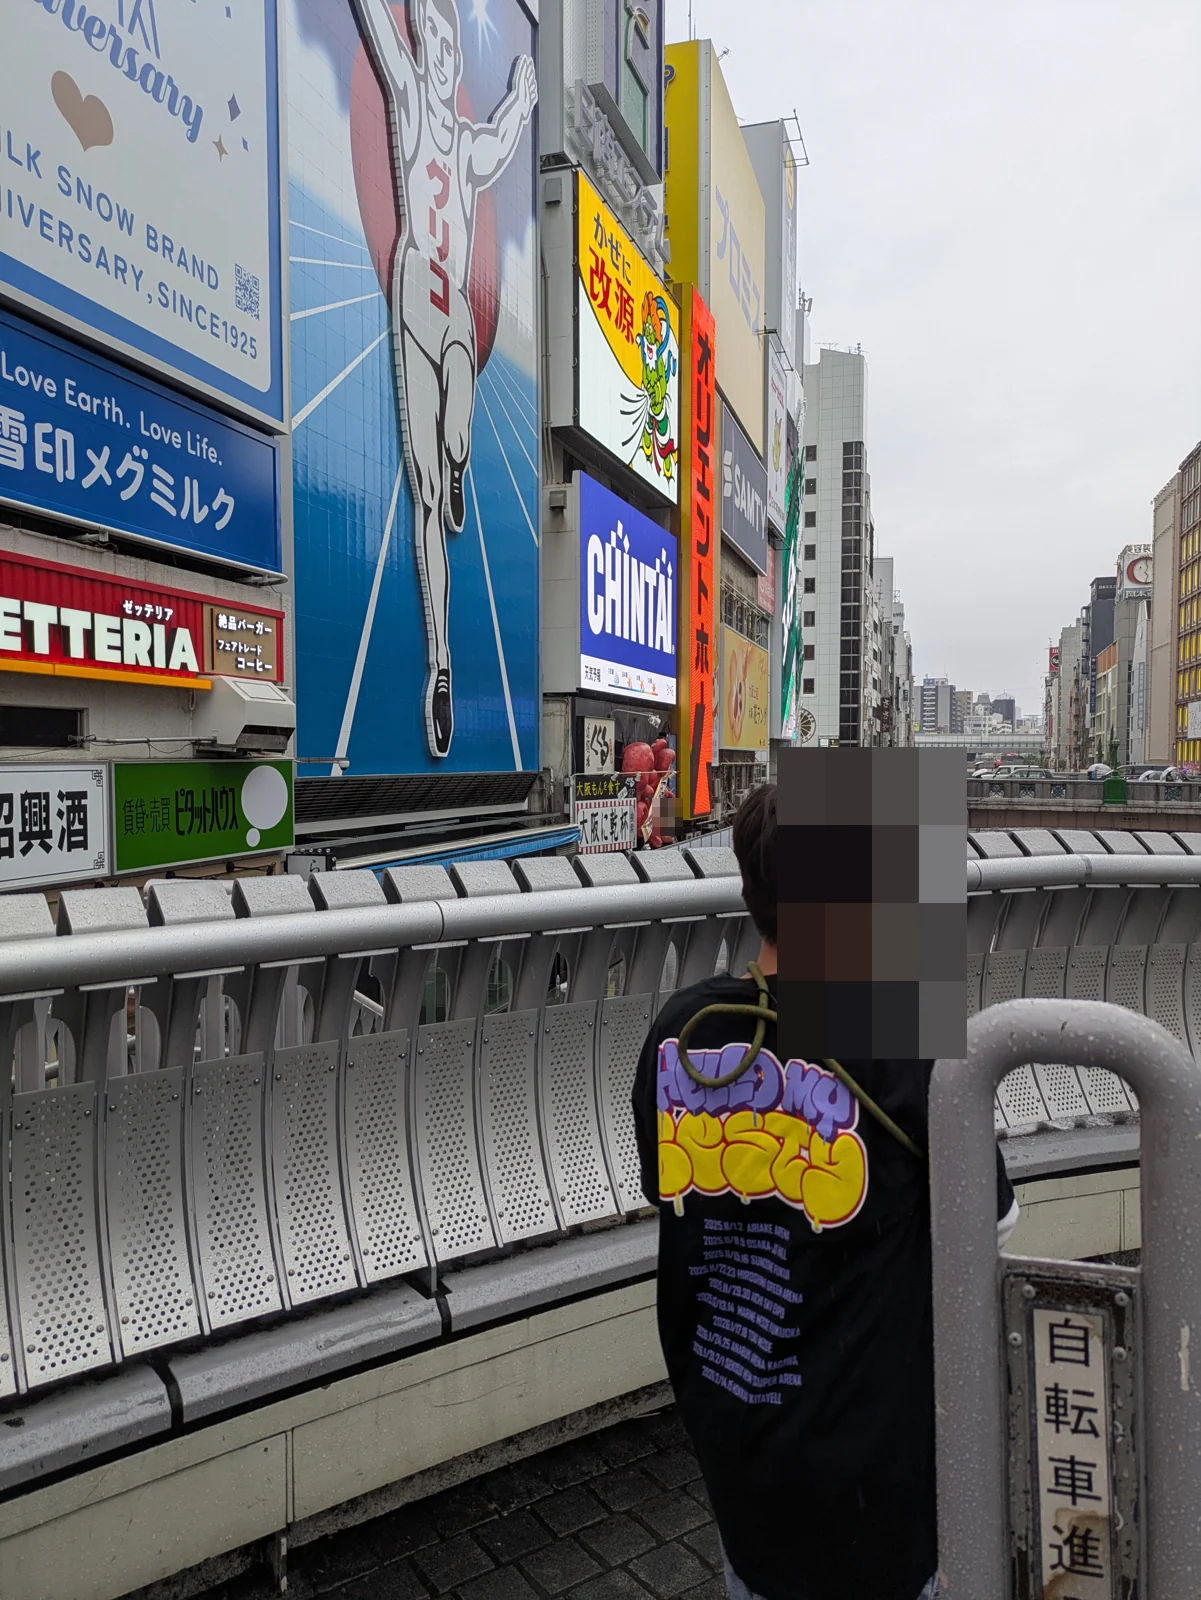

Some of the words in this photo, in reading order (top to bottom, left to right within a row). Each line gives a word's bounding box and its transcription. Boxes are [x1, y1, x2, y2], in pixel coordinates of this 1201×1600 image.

[0, 126, 42, 180] LK
[57, 165, 135, 237] SNOW
[146, 223, 219, 291] BRAND
[425, 156, 452, 318] グリコ
[593, 212, 633, 286] かぜに
[588, 246, 637, 345] 改源
[1, 352, 57, 399] Love
[64, 377, 131, 429] Earth.
[139, 410, 182, 449] Love
[187, 430, 223, 467] Life.
[734, 462, 767, 540] SAMTY
[123, 599, 174, 621] ゼッテリア
[218, 613, 273, 635] 絶品バーガー
[587, 520, 673, 655] CHINTAI
[218, 640, 263, 656] フェアトレード
[237, 657, 273, 672] コーヒー
[175, 786, 239, 836] ピタットハウス
[576, 780, 621, 797] 大阪もんを食す
[783, 1059, 858, 1143] MY
[747, 1223, 773, 1234] ARIAKE
[779, 1373, 802, 1386] ARENA
[1044, 1317, 1105, 1600] 自転車進
